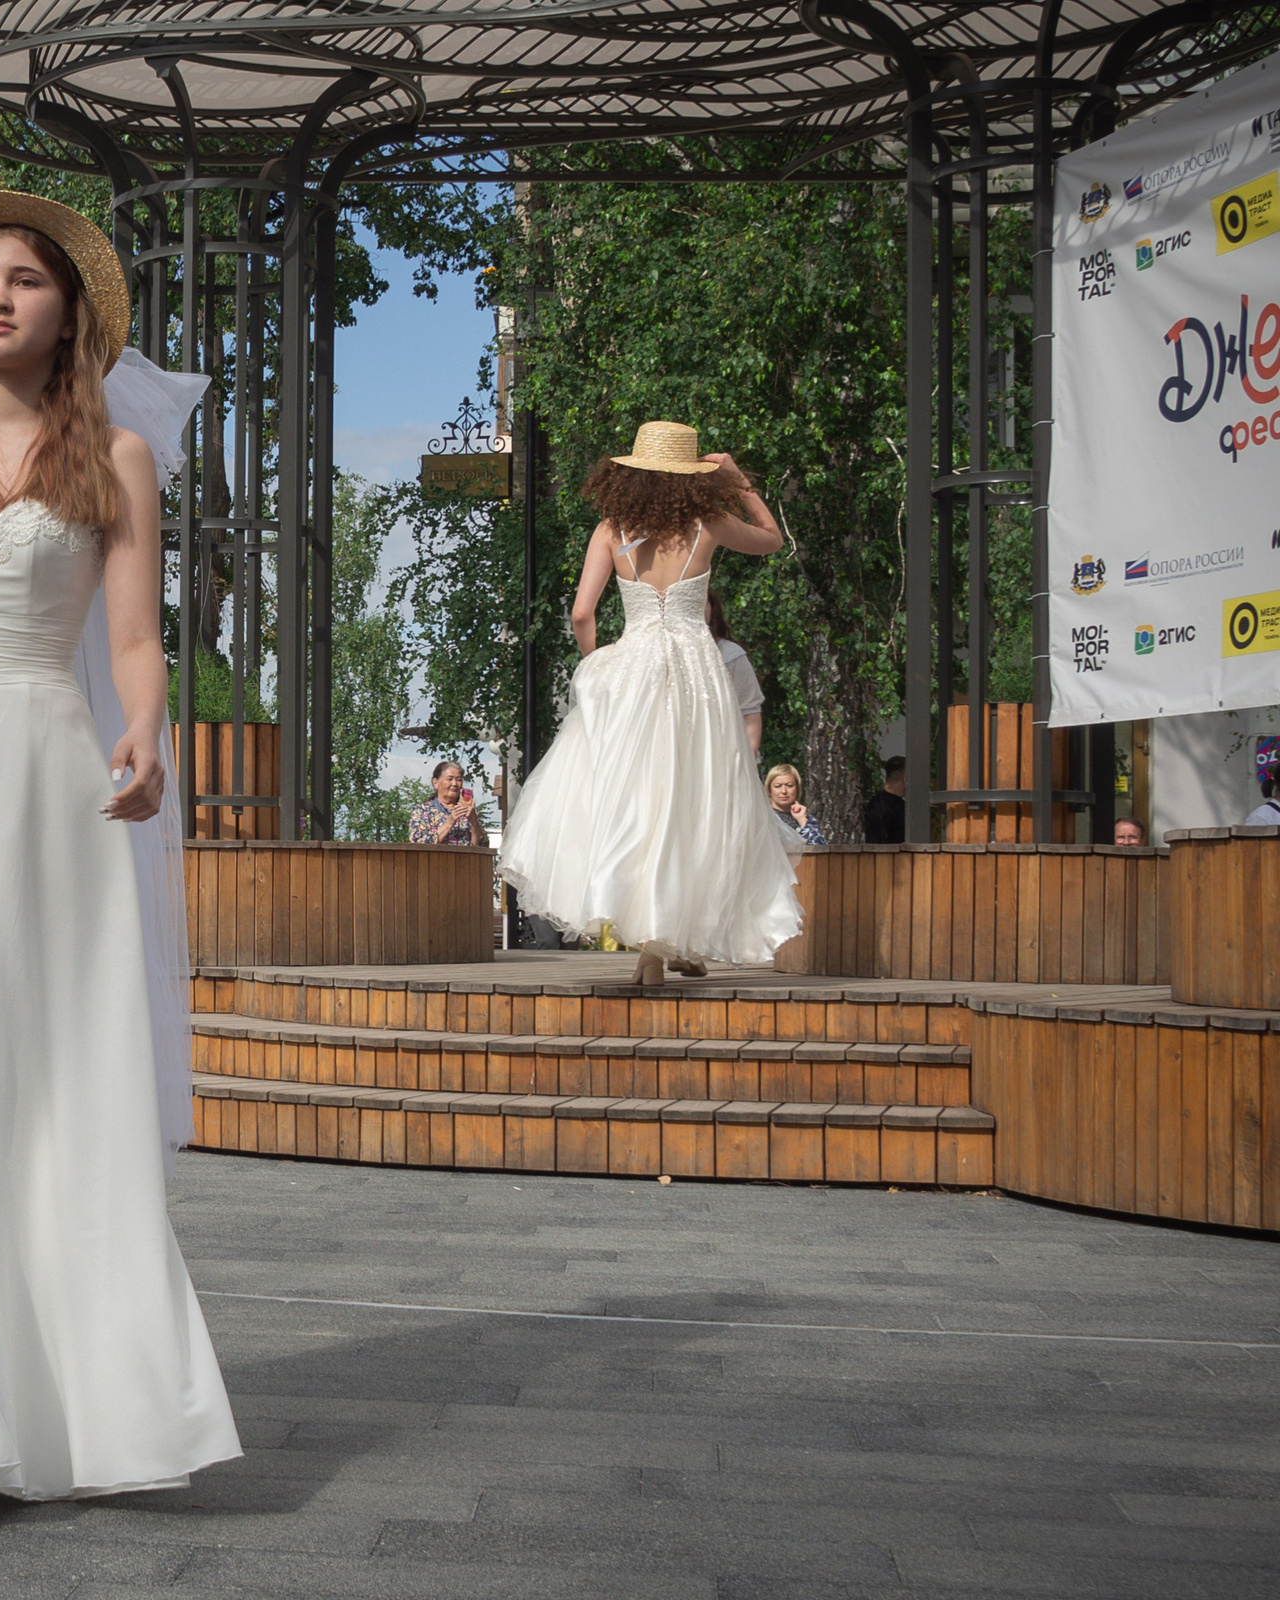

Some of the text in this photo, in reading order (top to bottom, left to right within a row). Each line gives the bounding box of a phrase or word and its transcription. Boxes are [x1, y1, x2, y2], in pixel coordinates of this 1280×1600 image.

[1143, 164, 1180, 191] ОПОРА
[1182, 142, 1230, 174] РОССИИ
[1247, 190, 1272, 206] МЕДИА
[1249, 201, 1272, 217] ТРАСТ
[1155, 230, 1192, 257] 2ГИС
[1081, 262, 1116, 286] POR
[1150, 557, 1193, 576] ОПОРА
[1195, 547, 1244, 569] РОССИИ
[1261, 617, 1280, 628] ТРАС
[1158, 625, 1196, 646] 2ГИС
[1075, 639, 1109, 658] POR
